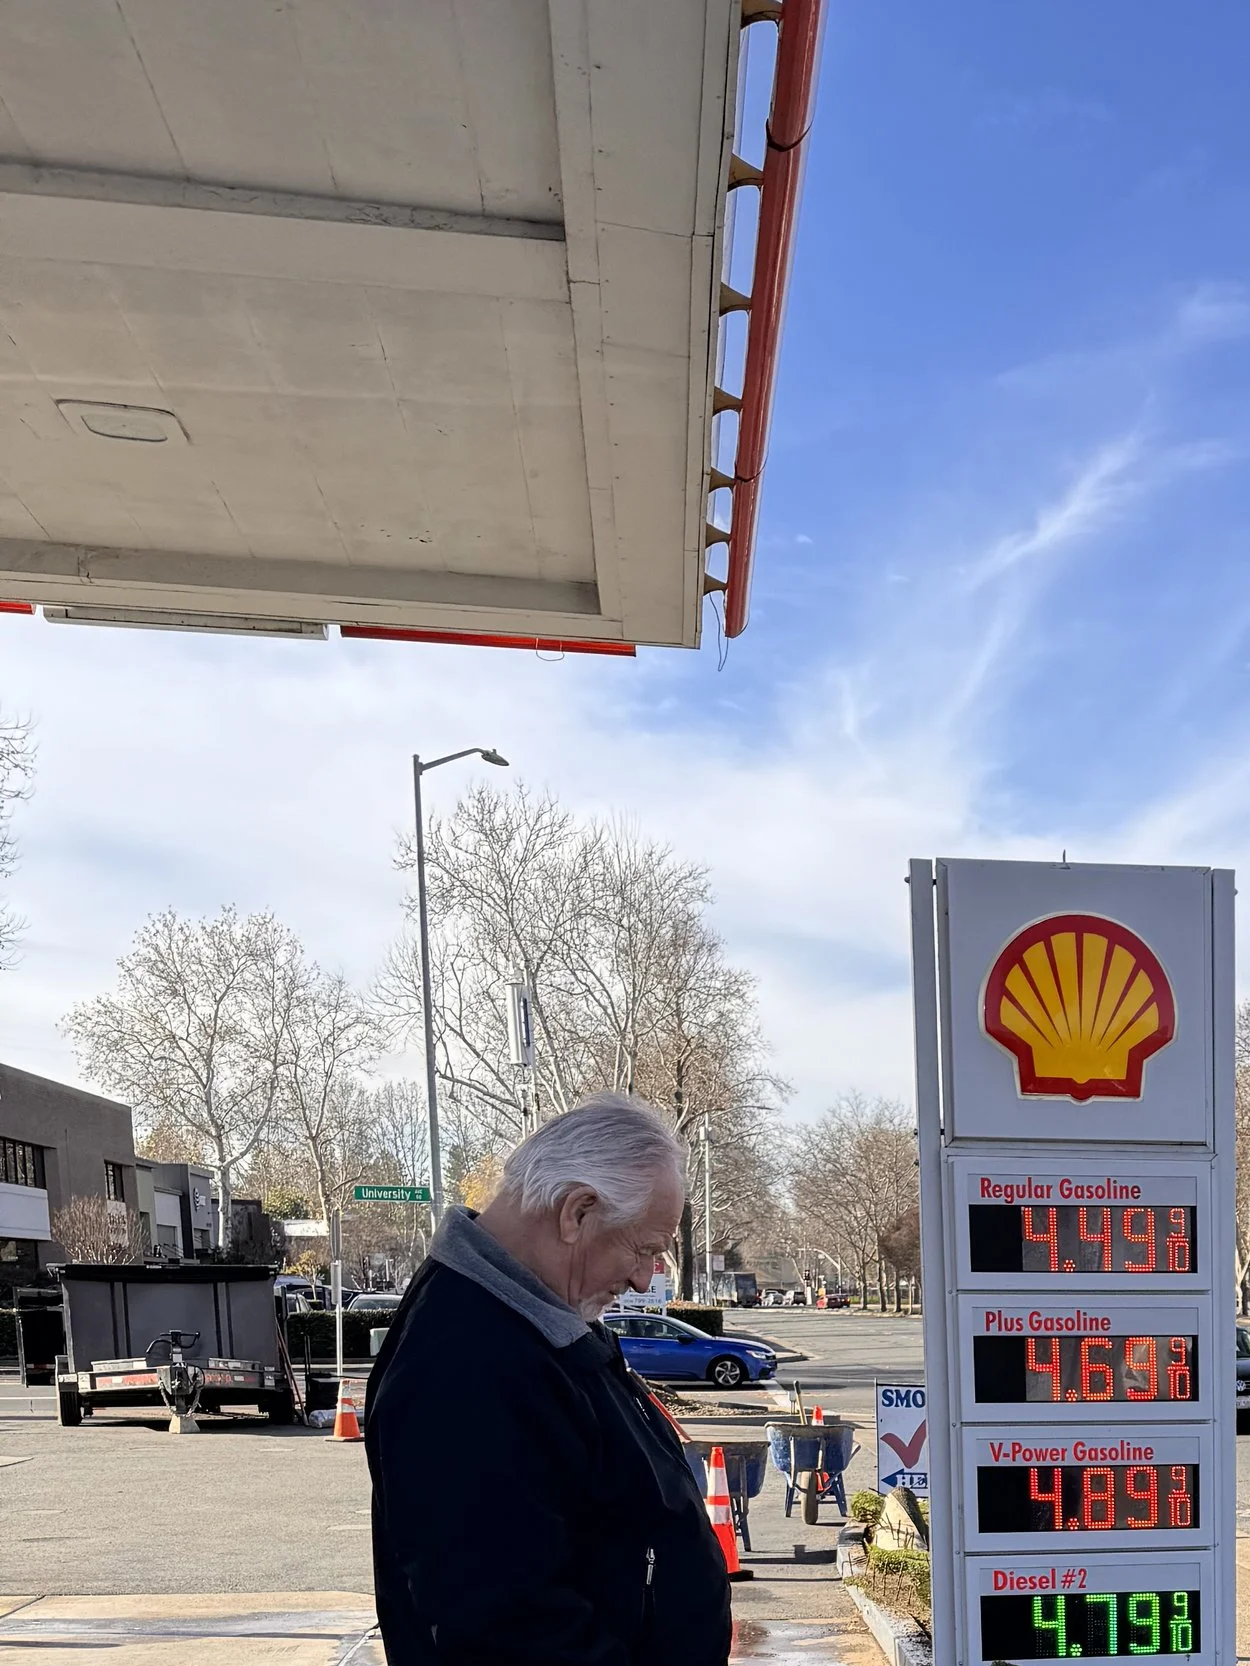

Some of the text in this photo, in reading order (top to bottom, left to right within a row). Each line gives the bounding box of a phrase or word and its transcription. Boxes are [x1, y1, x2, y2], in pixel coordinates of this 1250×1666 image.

[361, 1187, 412, 1201] University
[980, 1176, 1142, 1204] Regular Gasoline
[1024, 1206, 1156, 1272] 4.49
[985, 1310, 1112, 1332] Plus Gasoline
[1026, 1336, 1158, 1402] 4.69
[881, 1388, 926, 1409] SMO
[989, 1440, 1155, 1463] V-Power Gasoline
[1029, 1466, 1159, 1530] 4.89
[993, 1567, 1088, 1591] Diesel #2
[1033, 1593, 1161, 1657] 4.79
